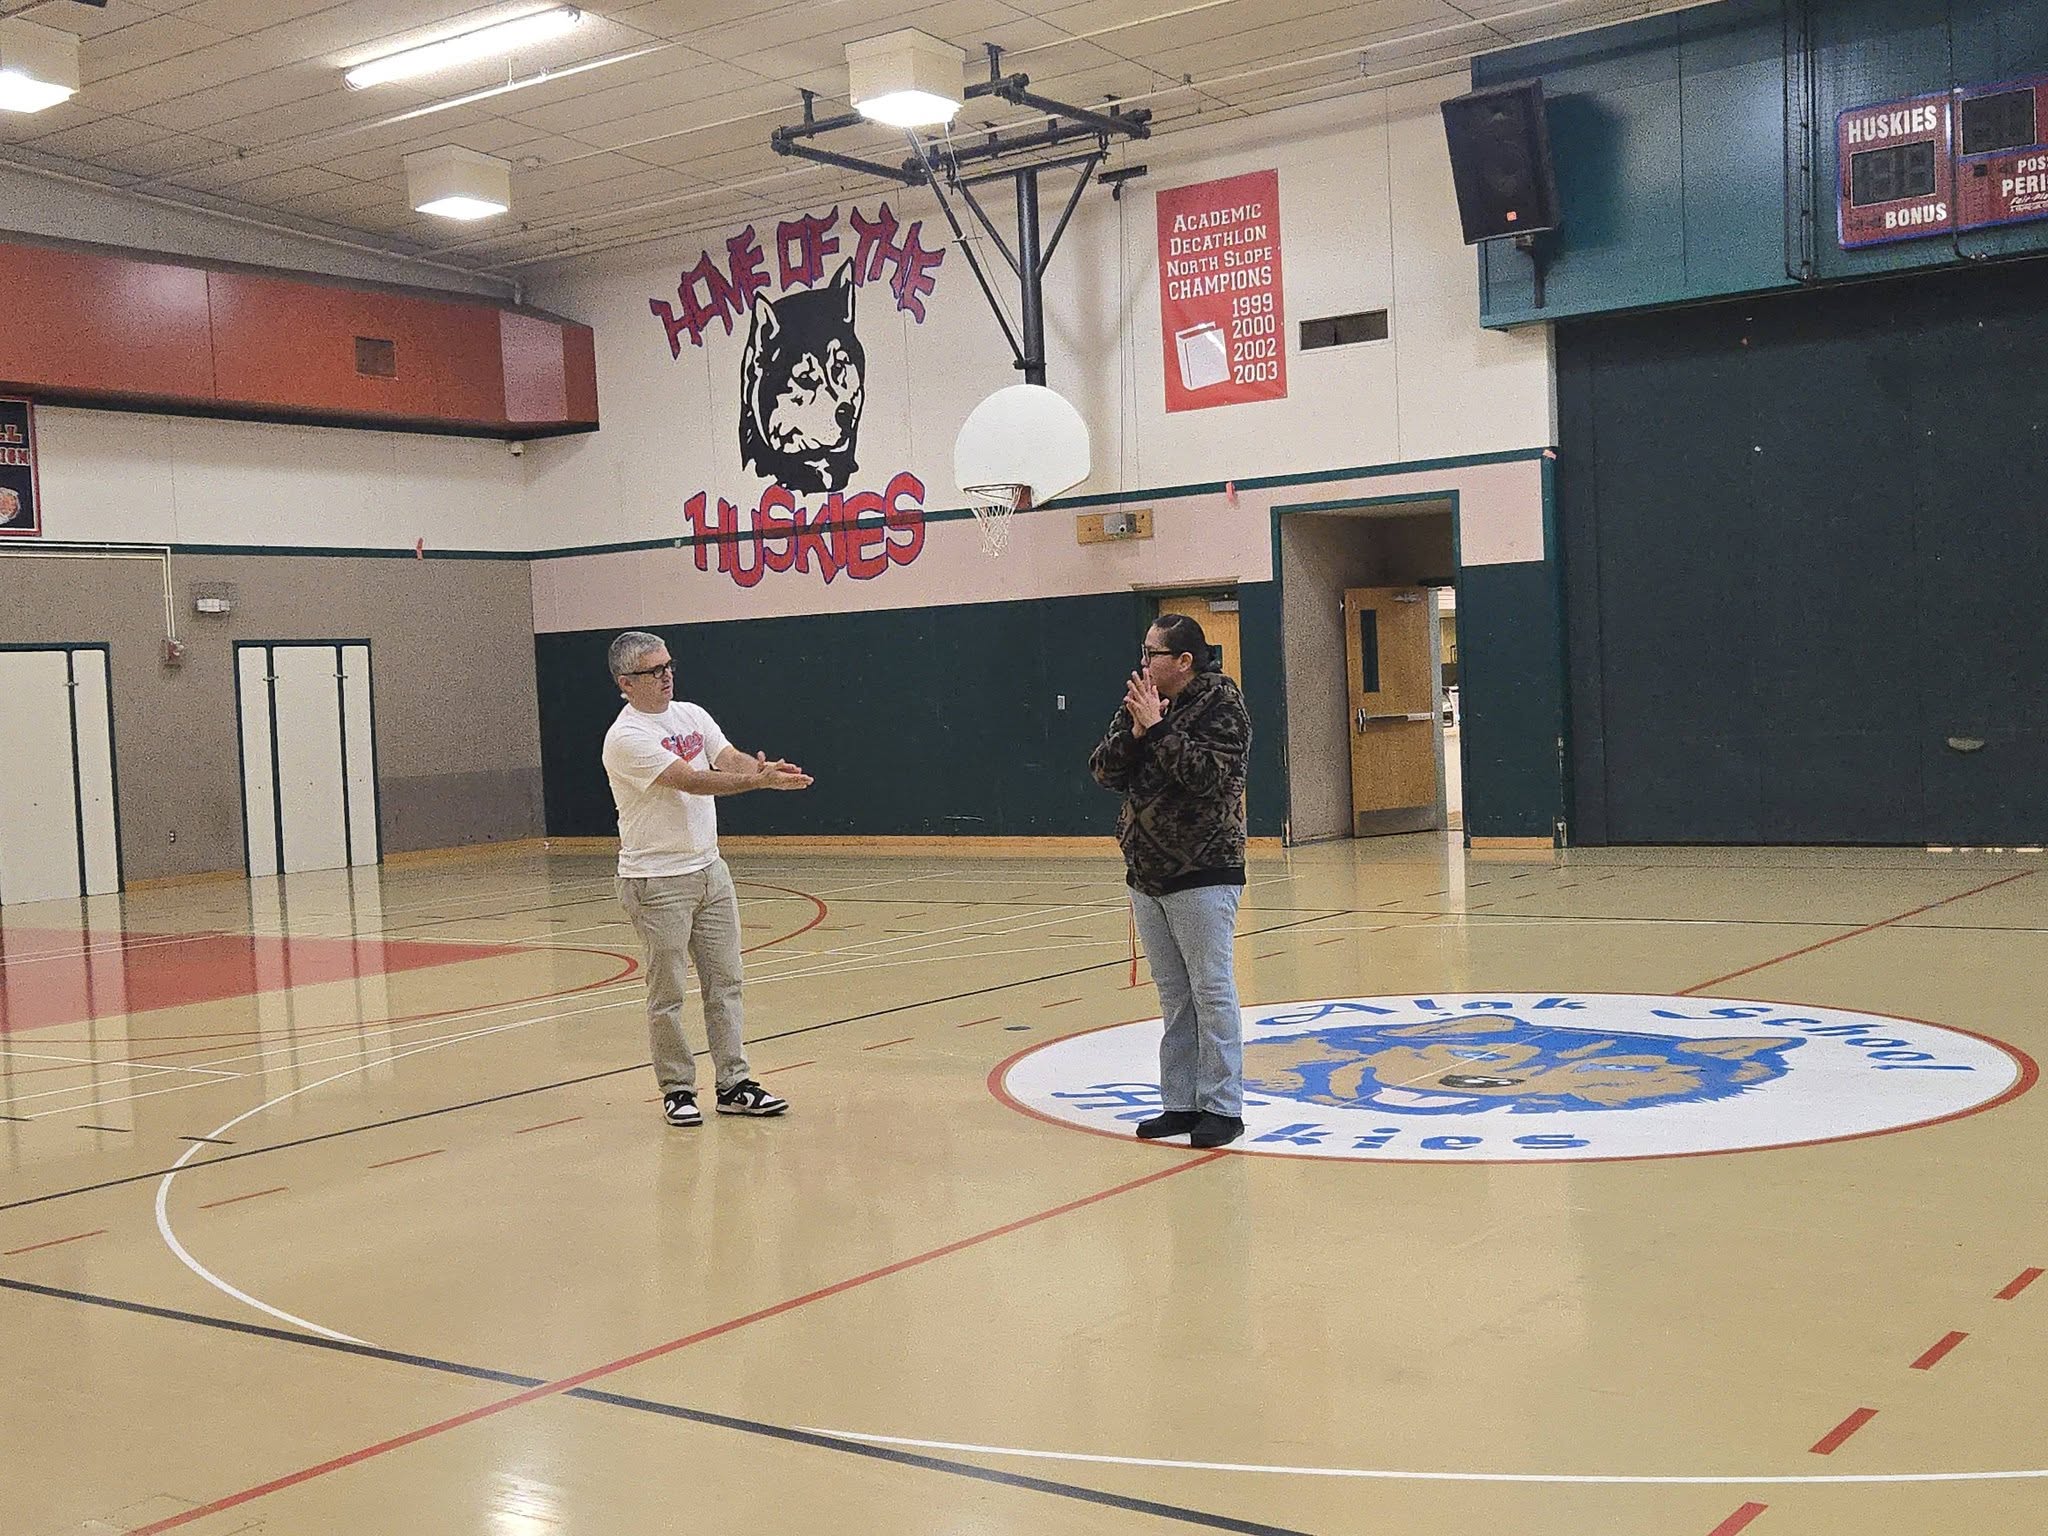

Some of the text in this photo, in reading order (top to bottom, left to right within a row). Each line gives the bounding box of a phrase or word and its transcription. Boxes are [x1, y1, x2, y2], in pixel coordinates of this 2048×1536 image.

[1848, 105, 1937, 144] HUSKIES
[2018, 155, 2048, 173] POS
[2002, 173, 2048, 197] PERI
[1173, 203, 1262, 233] ACADEMIC
[1885, 202, 1947, 229] BONUS
[1170, 225, 1267, 256] DECATHLON
[1167, 246, 1273, 277] NORTH SLOPE
[649, 202, 946, 360] HOME OF THE
[1168, 265, 1272, 301] CHAMPIONS
[1232, 293, 1273, 318] 1999
[1232, 314, 1275, 339] 2000
[1234, 338, 1276, 362] 2002
[1234, 360, 1278, 384] 2003
[684, 471, 926, 588] HUSKIES
[1254, 996, 1975, 1072] Alak School
